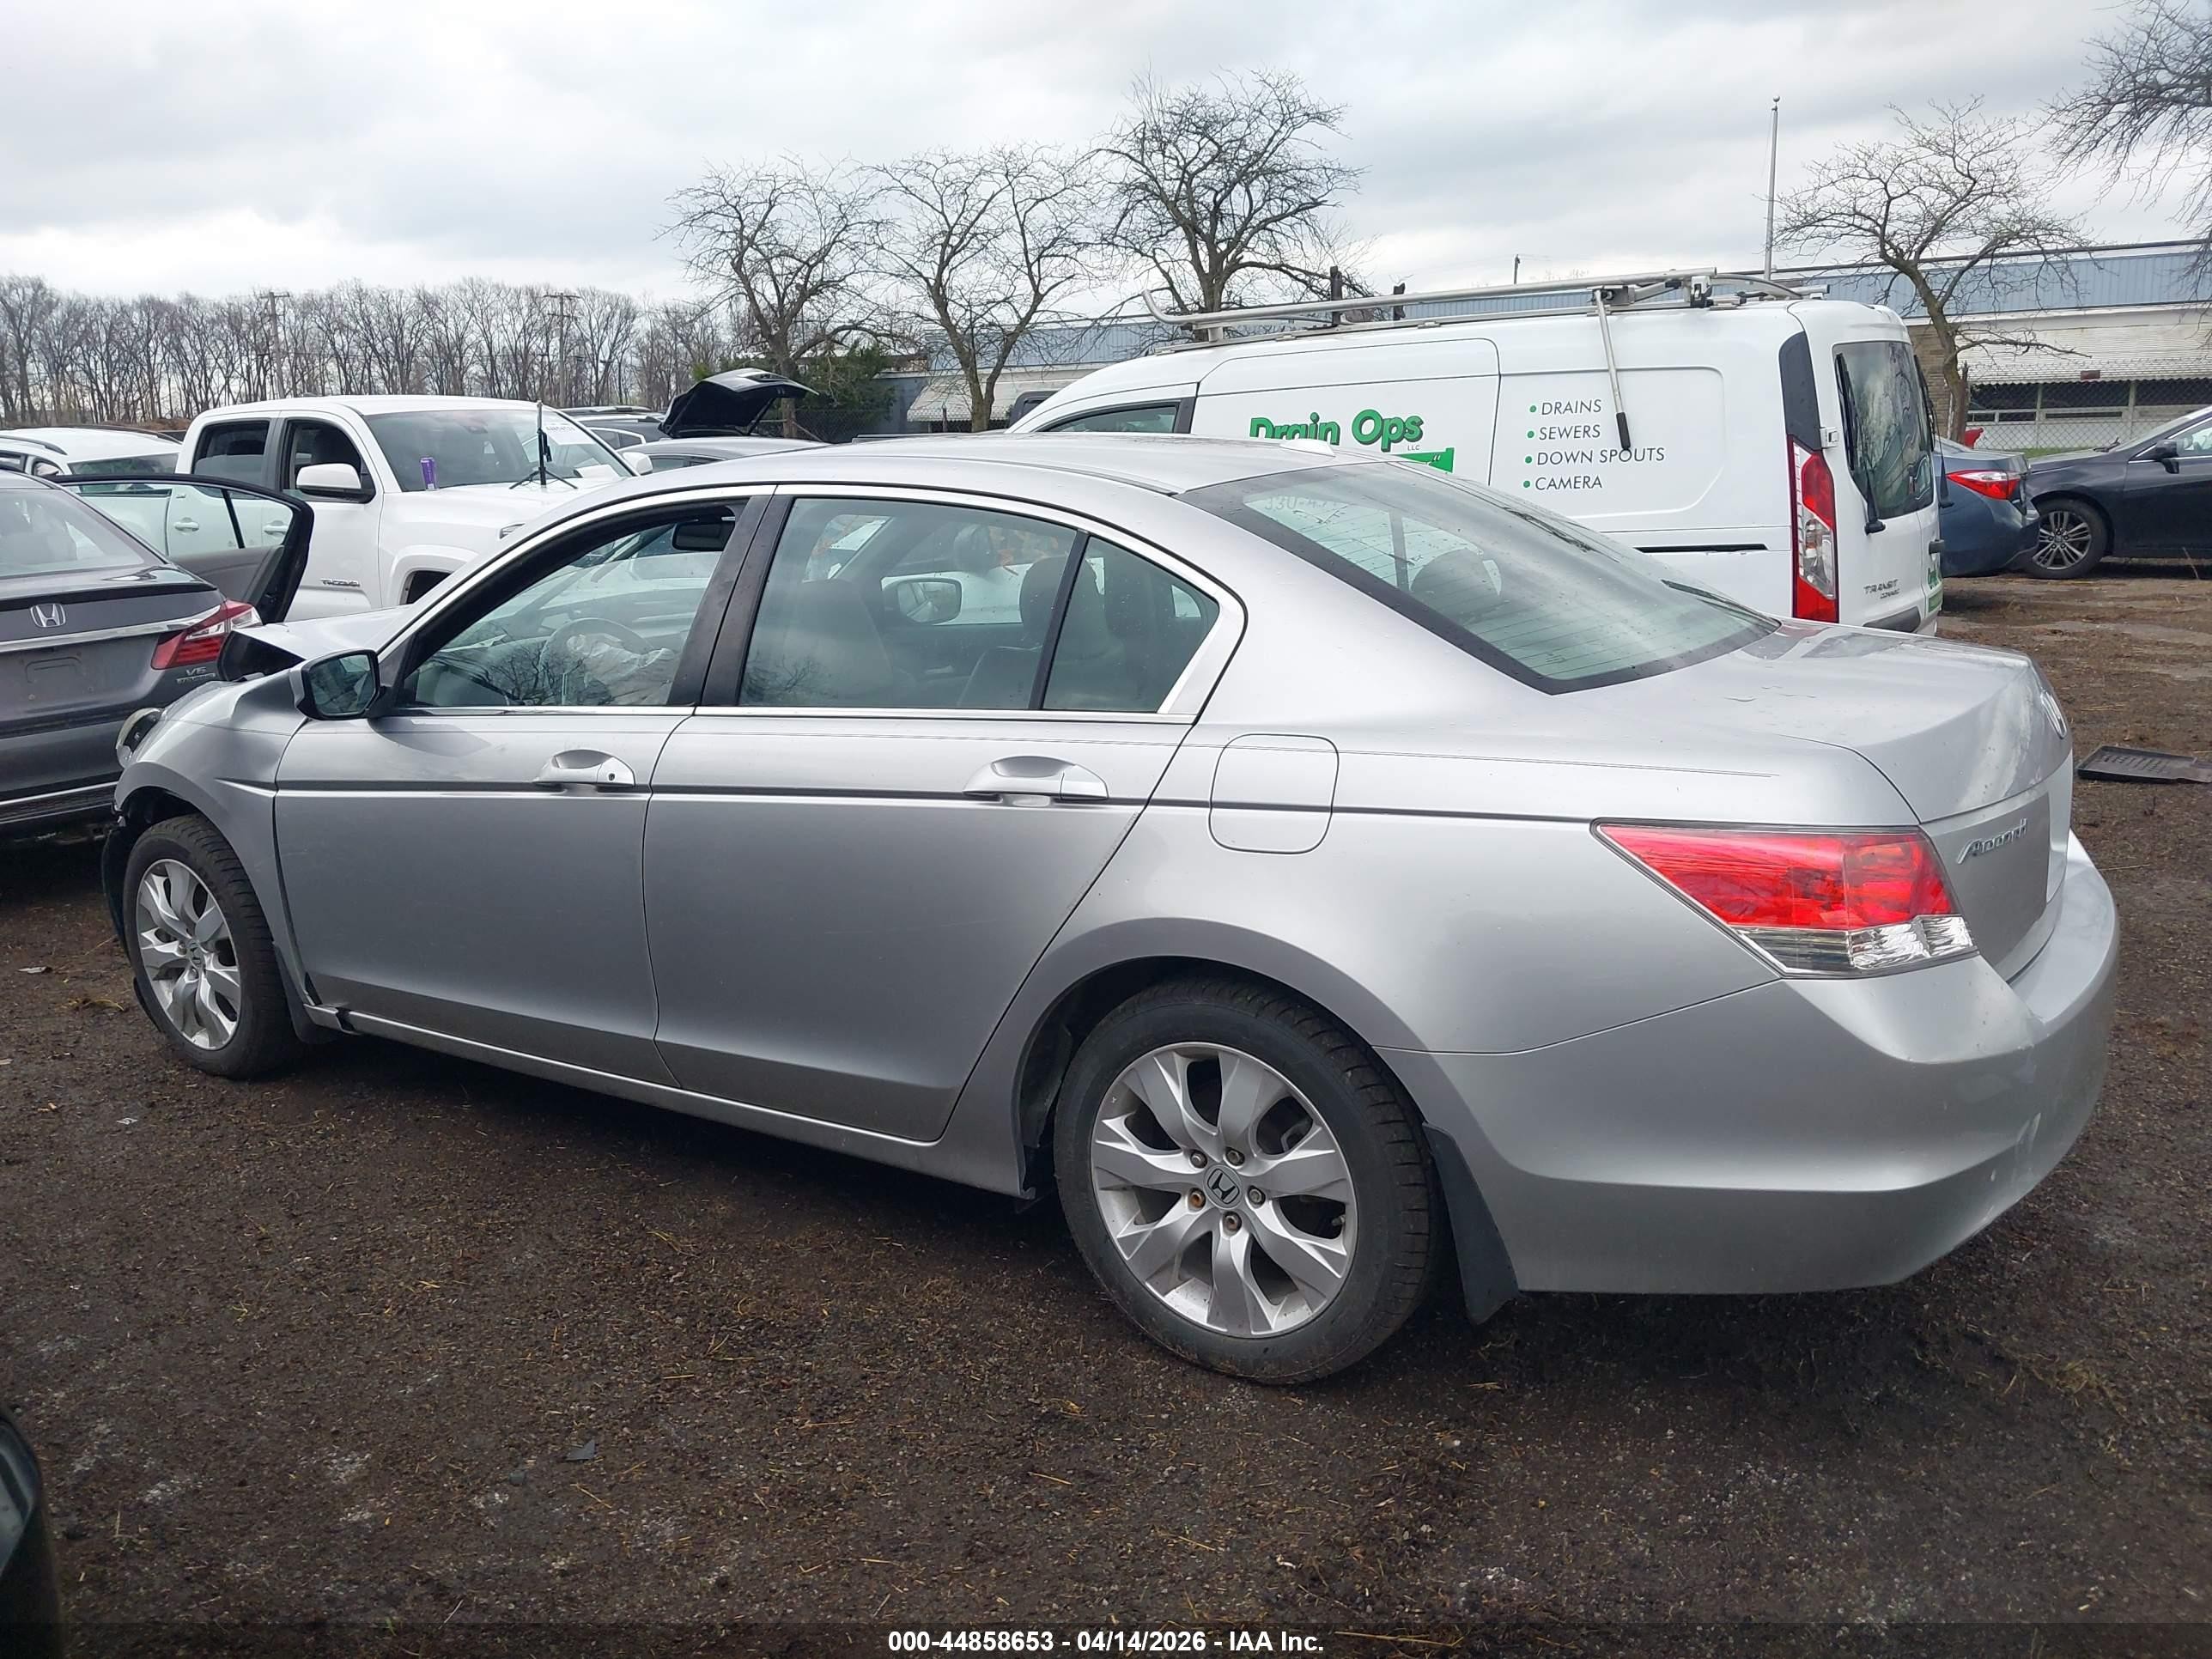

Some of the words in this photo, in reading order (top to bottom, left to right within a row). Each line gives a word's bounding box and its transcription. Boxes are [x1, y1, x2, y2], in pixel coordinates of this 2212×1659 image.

[1541, 399, 1601, 415] DRAINS
[1249, 412, 1340, 446] Drain
[1352, 409, 1424, 453] Ops
[1539, 424, 1601, 440] SEWERS
[1537, 450, 1593, 465] DOWN
[1599, 447, 1665, 463] SPOUTS
[1534, 475, 1602, 490] CAMERA
[185, 666, 206, 676] V6
